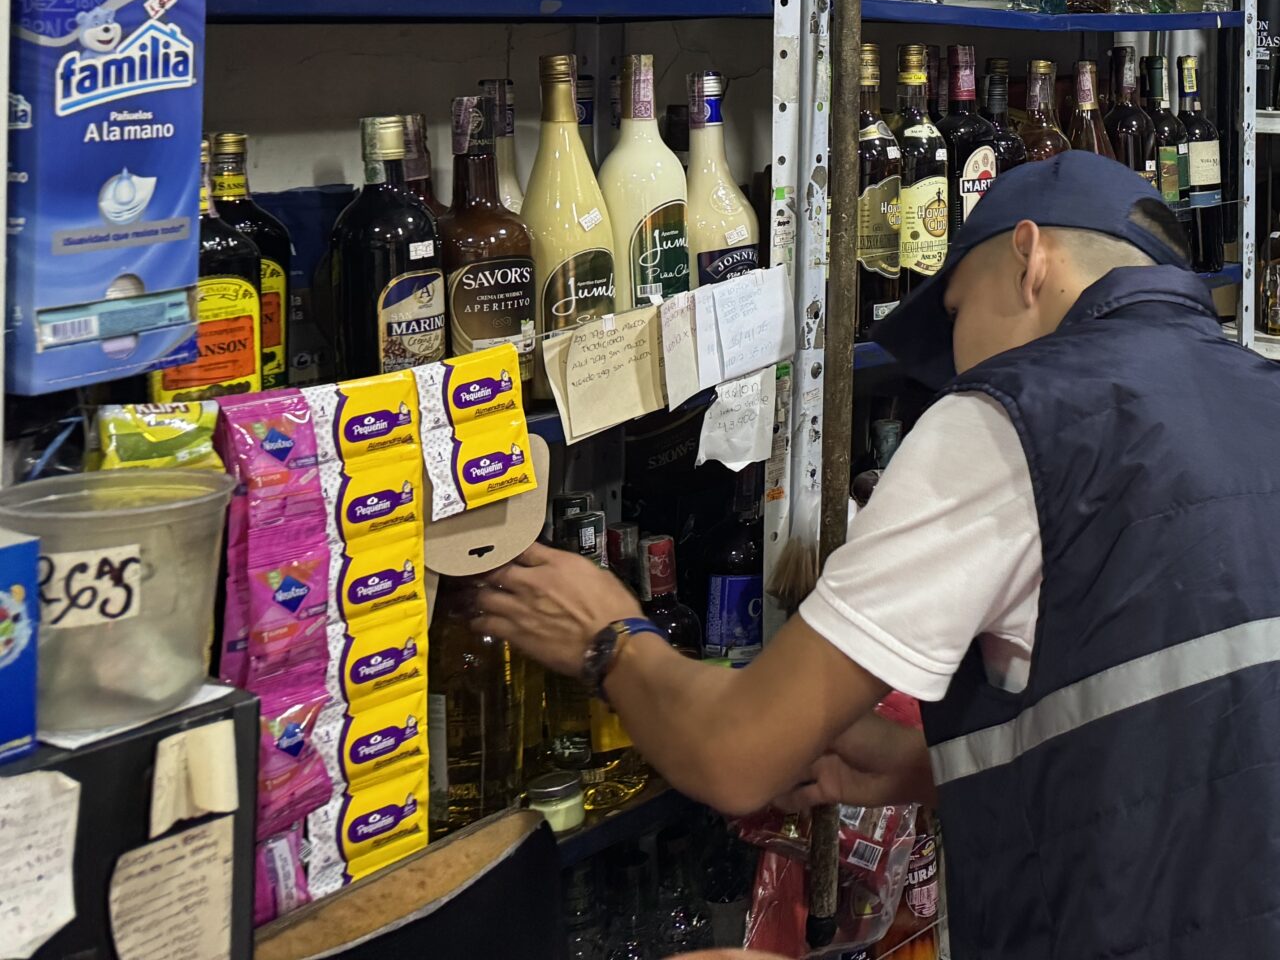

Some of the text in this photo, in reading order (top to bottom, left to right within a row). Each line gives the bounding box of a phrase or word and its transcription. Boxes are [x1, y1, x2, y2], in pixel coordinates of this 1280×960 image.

[60, 36, 192, 101] familia
[110, 109, 153, 122] Pañuelos
[84, 120, 174, 143] A la mano
[464, 297, 531, 313] APERITIVO
[391, 315, 445, 336] MARINO
[487, 476, 519, 491] Almendra
